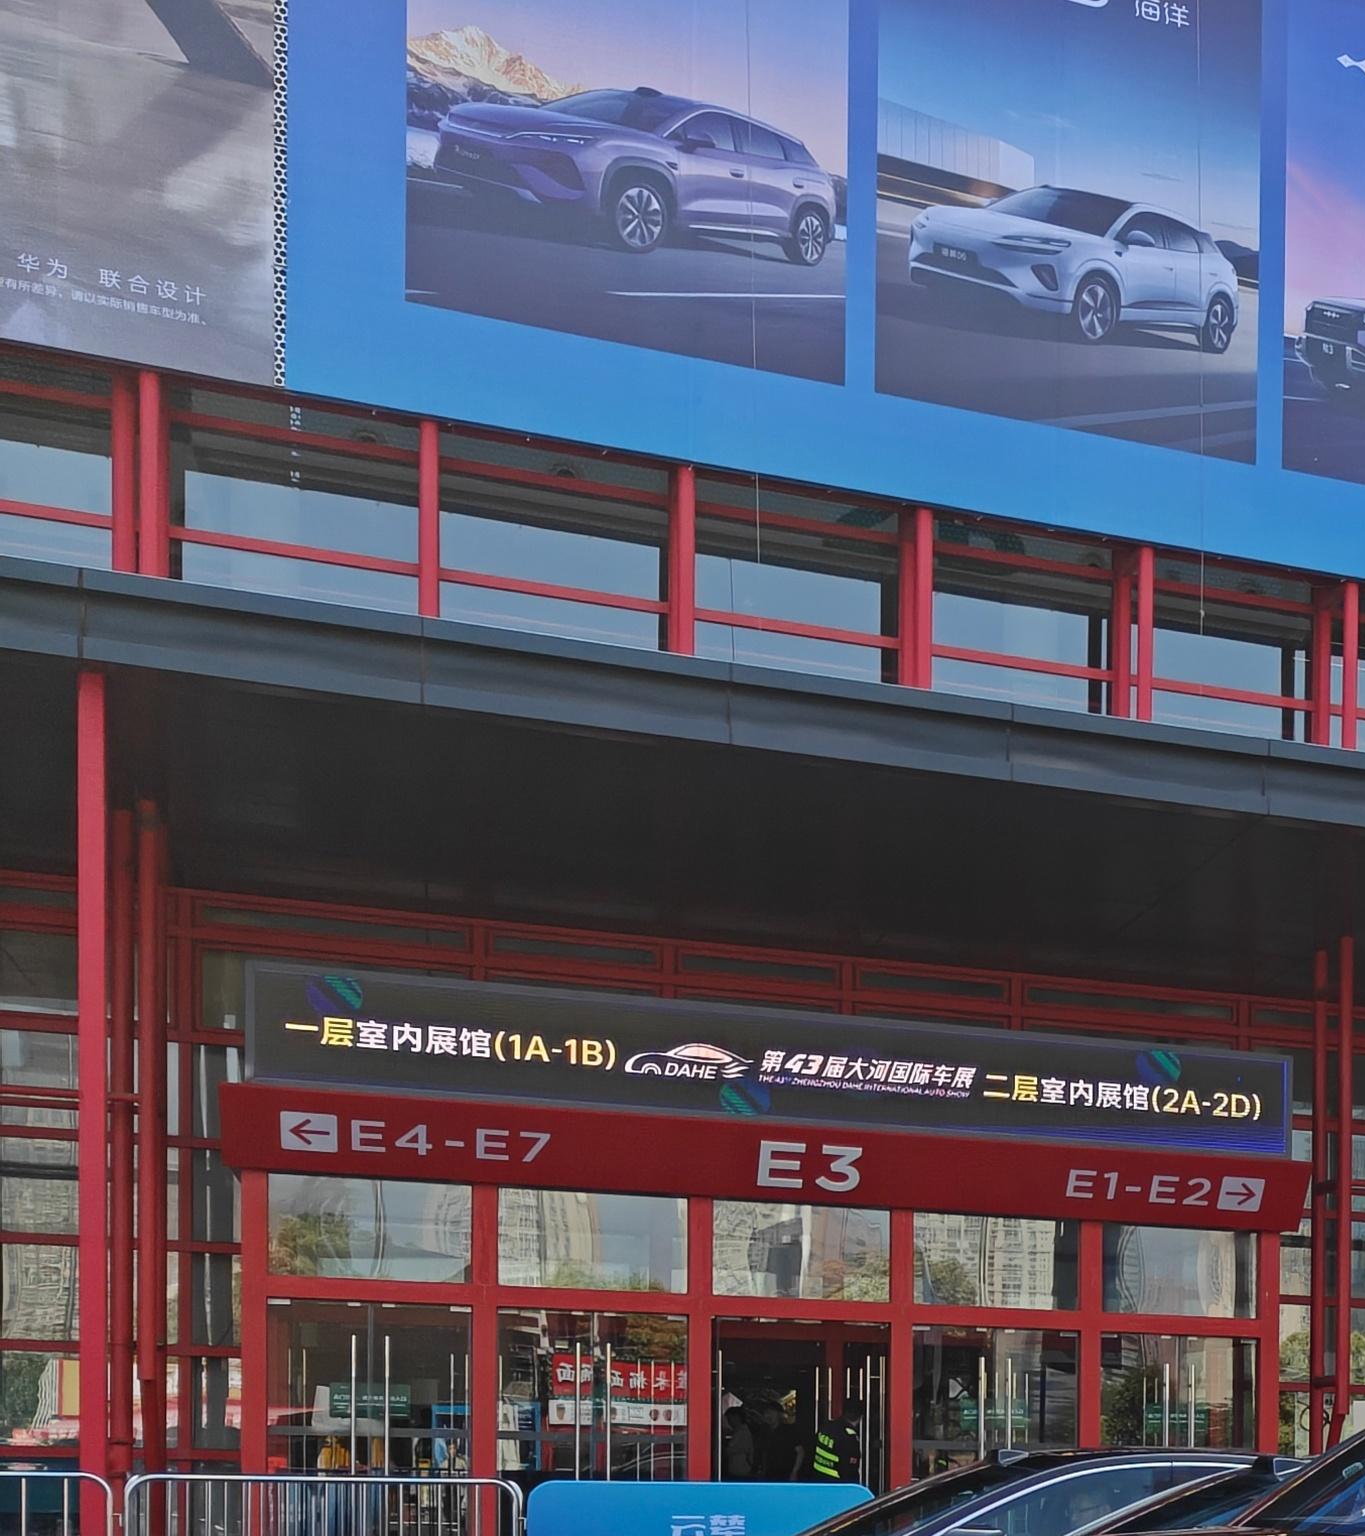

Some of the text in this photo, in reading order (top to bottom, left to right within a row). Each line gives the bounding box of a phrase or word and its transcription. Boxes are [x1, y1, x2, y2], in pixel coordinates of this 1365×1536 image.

[16, 251, 208, 307] 华为 联合设计
[285, 1016, 617, 1072] 一层室内展馆(1A-1B)
[663, 1060, 719, 1081] DAHE
[759, 1049, 978, 1090] 第43届大河国际车展
[982, 1072, 1262, 1122] 二层室内展馆(2A-2D)
[350, 1118, 553, 1164] E4-E7
[756, 1139, 864, 1193] E3
[1065, 1168, 1213, 1208] E1-E2
